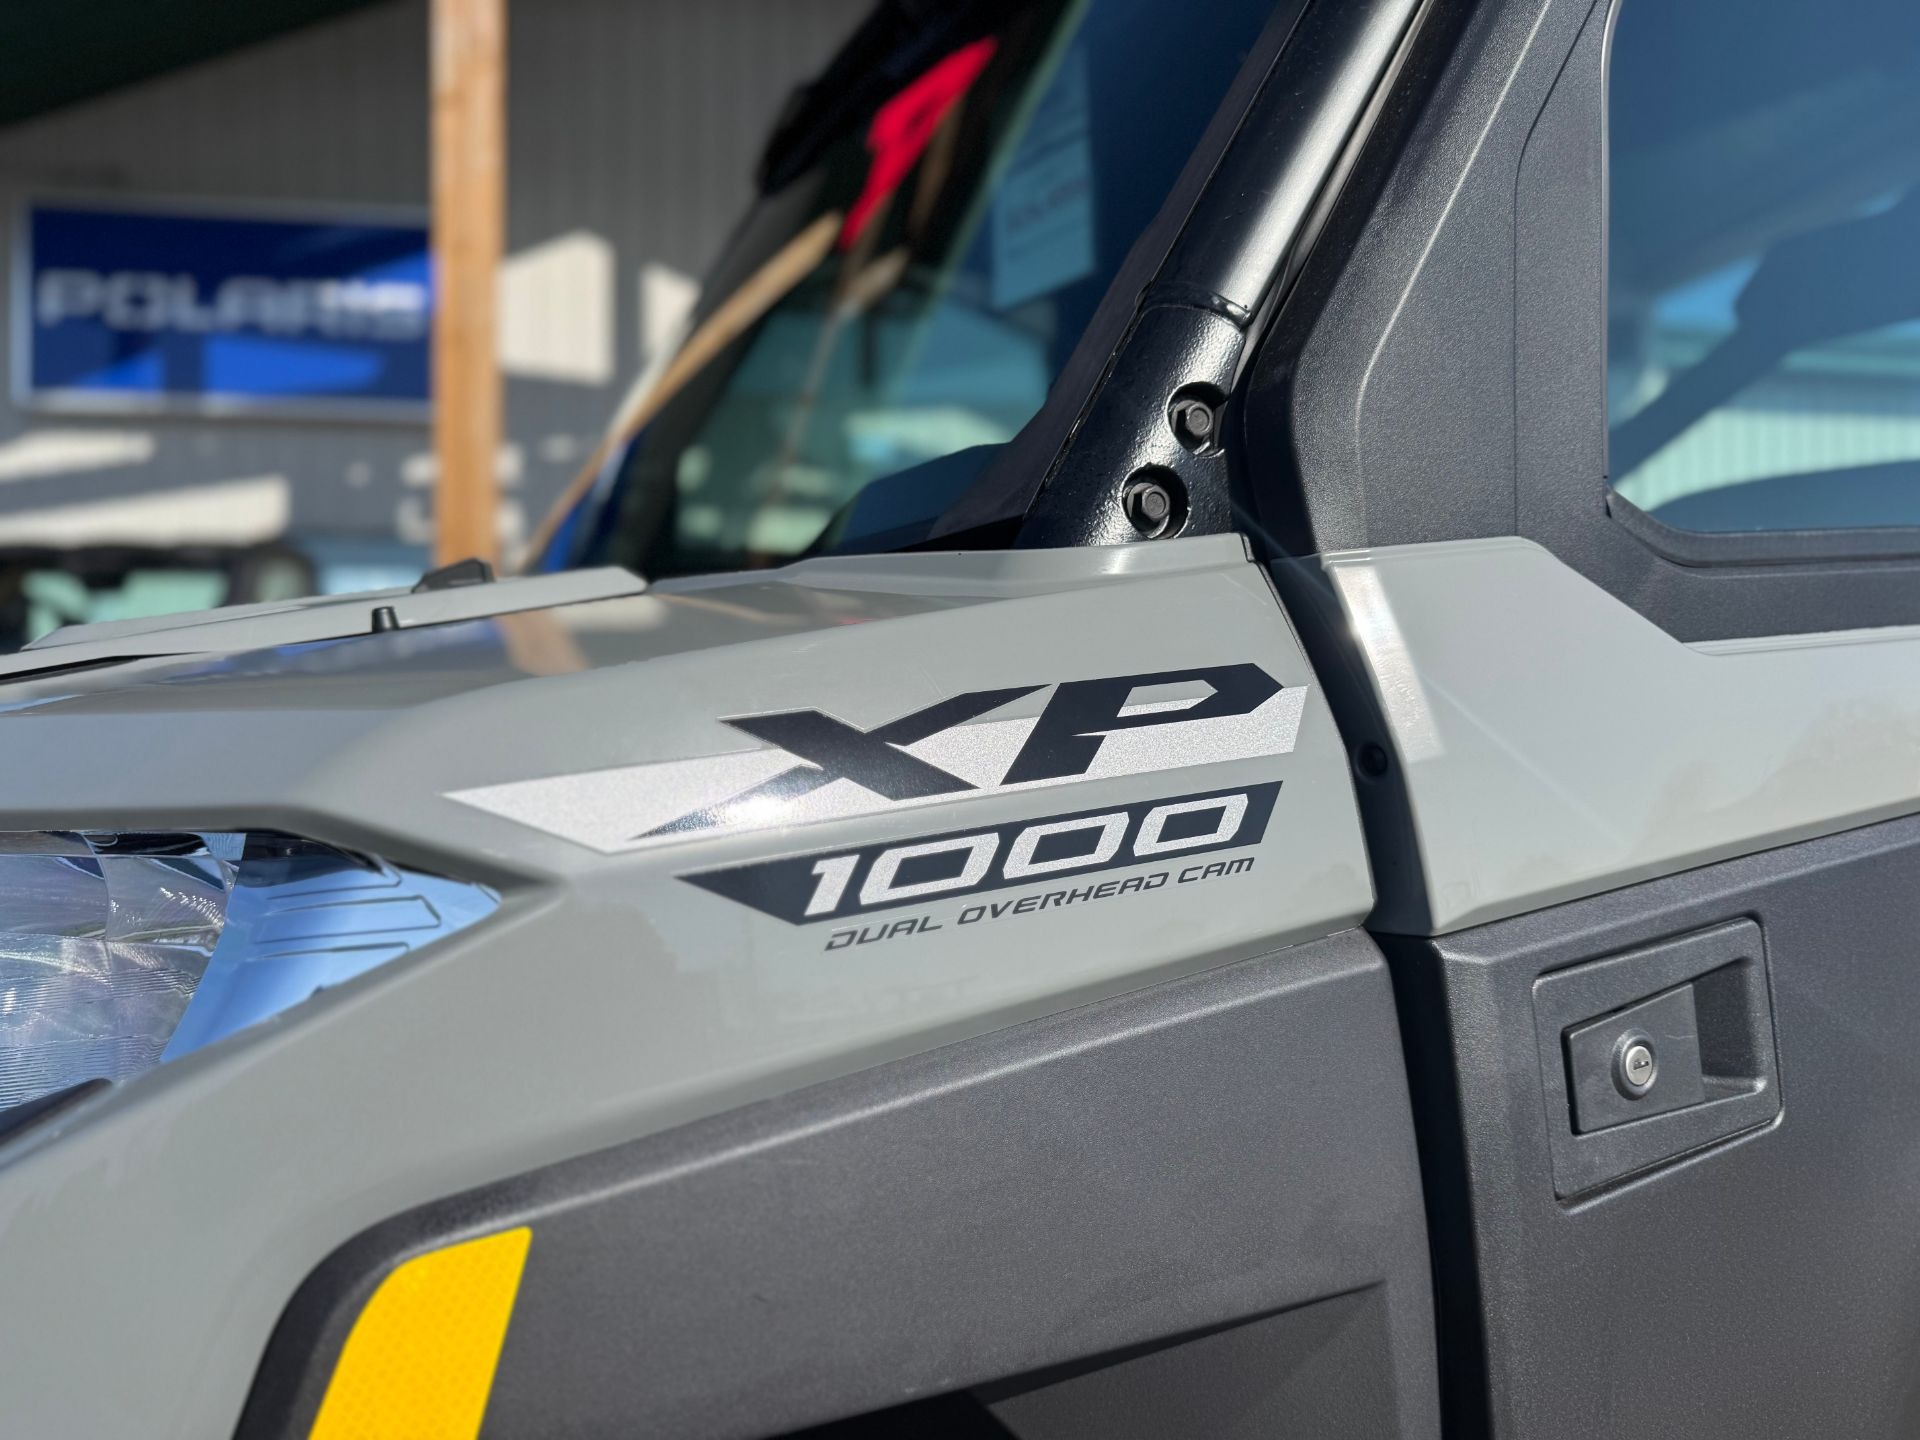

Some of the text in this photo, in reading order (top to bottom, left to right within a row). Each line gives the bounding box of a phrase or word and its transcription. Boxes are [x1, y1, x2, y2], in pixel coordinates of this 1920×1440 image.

[638, 663, 1284, 838] XP
[804, 794, 1249, 916] 1000
[824, 857, 1255, 951] DUAL OVERHEAD CAM
